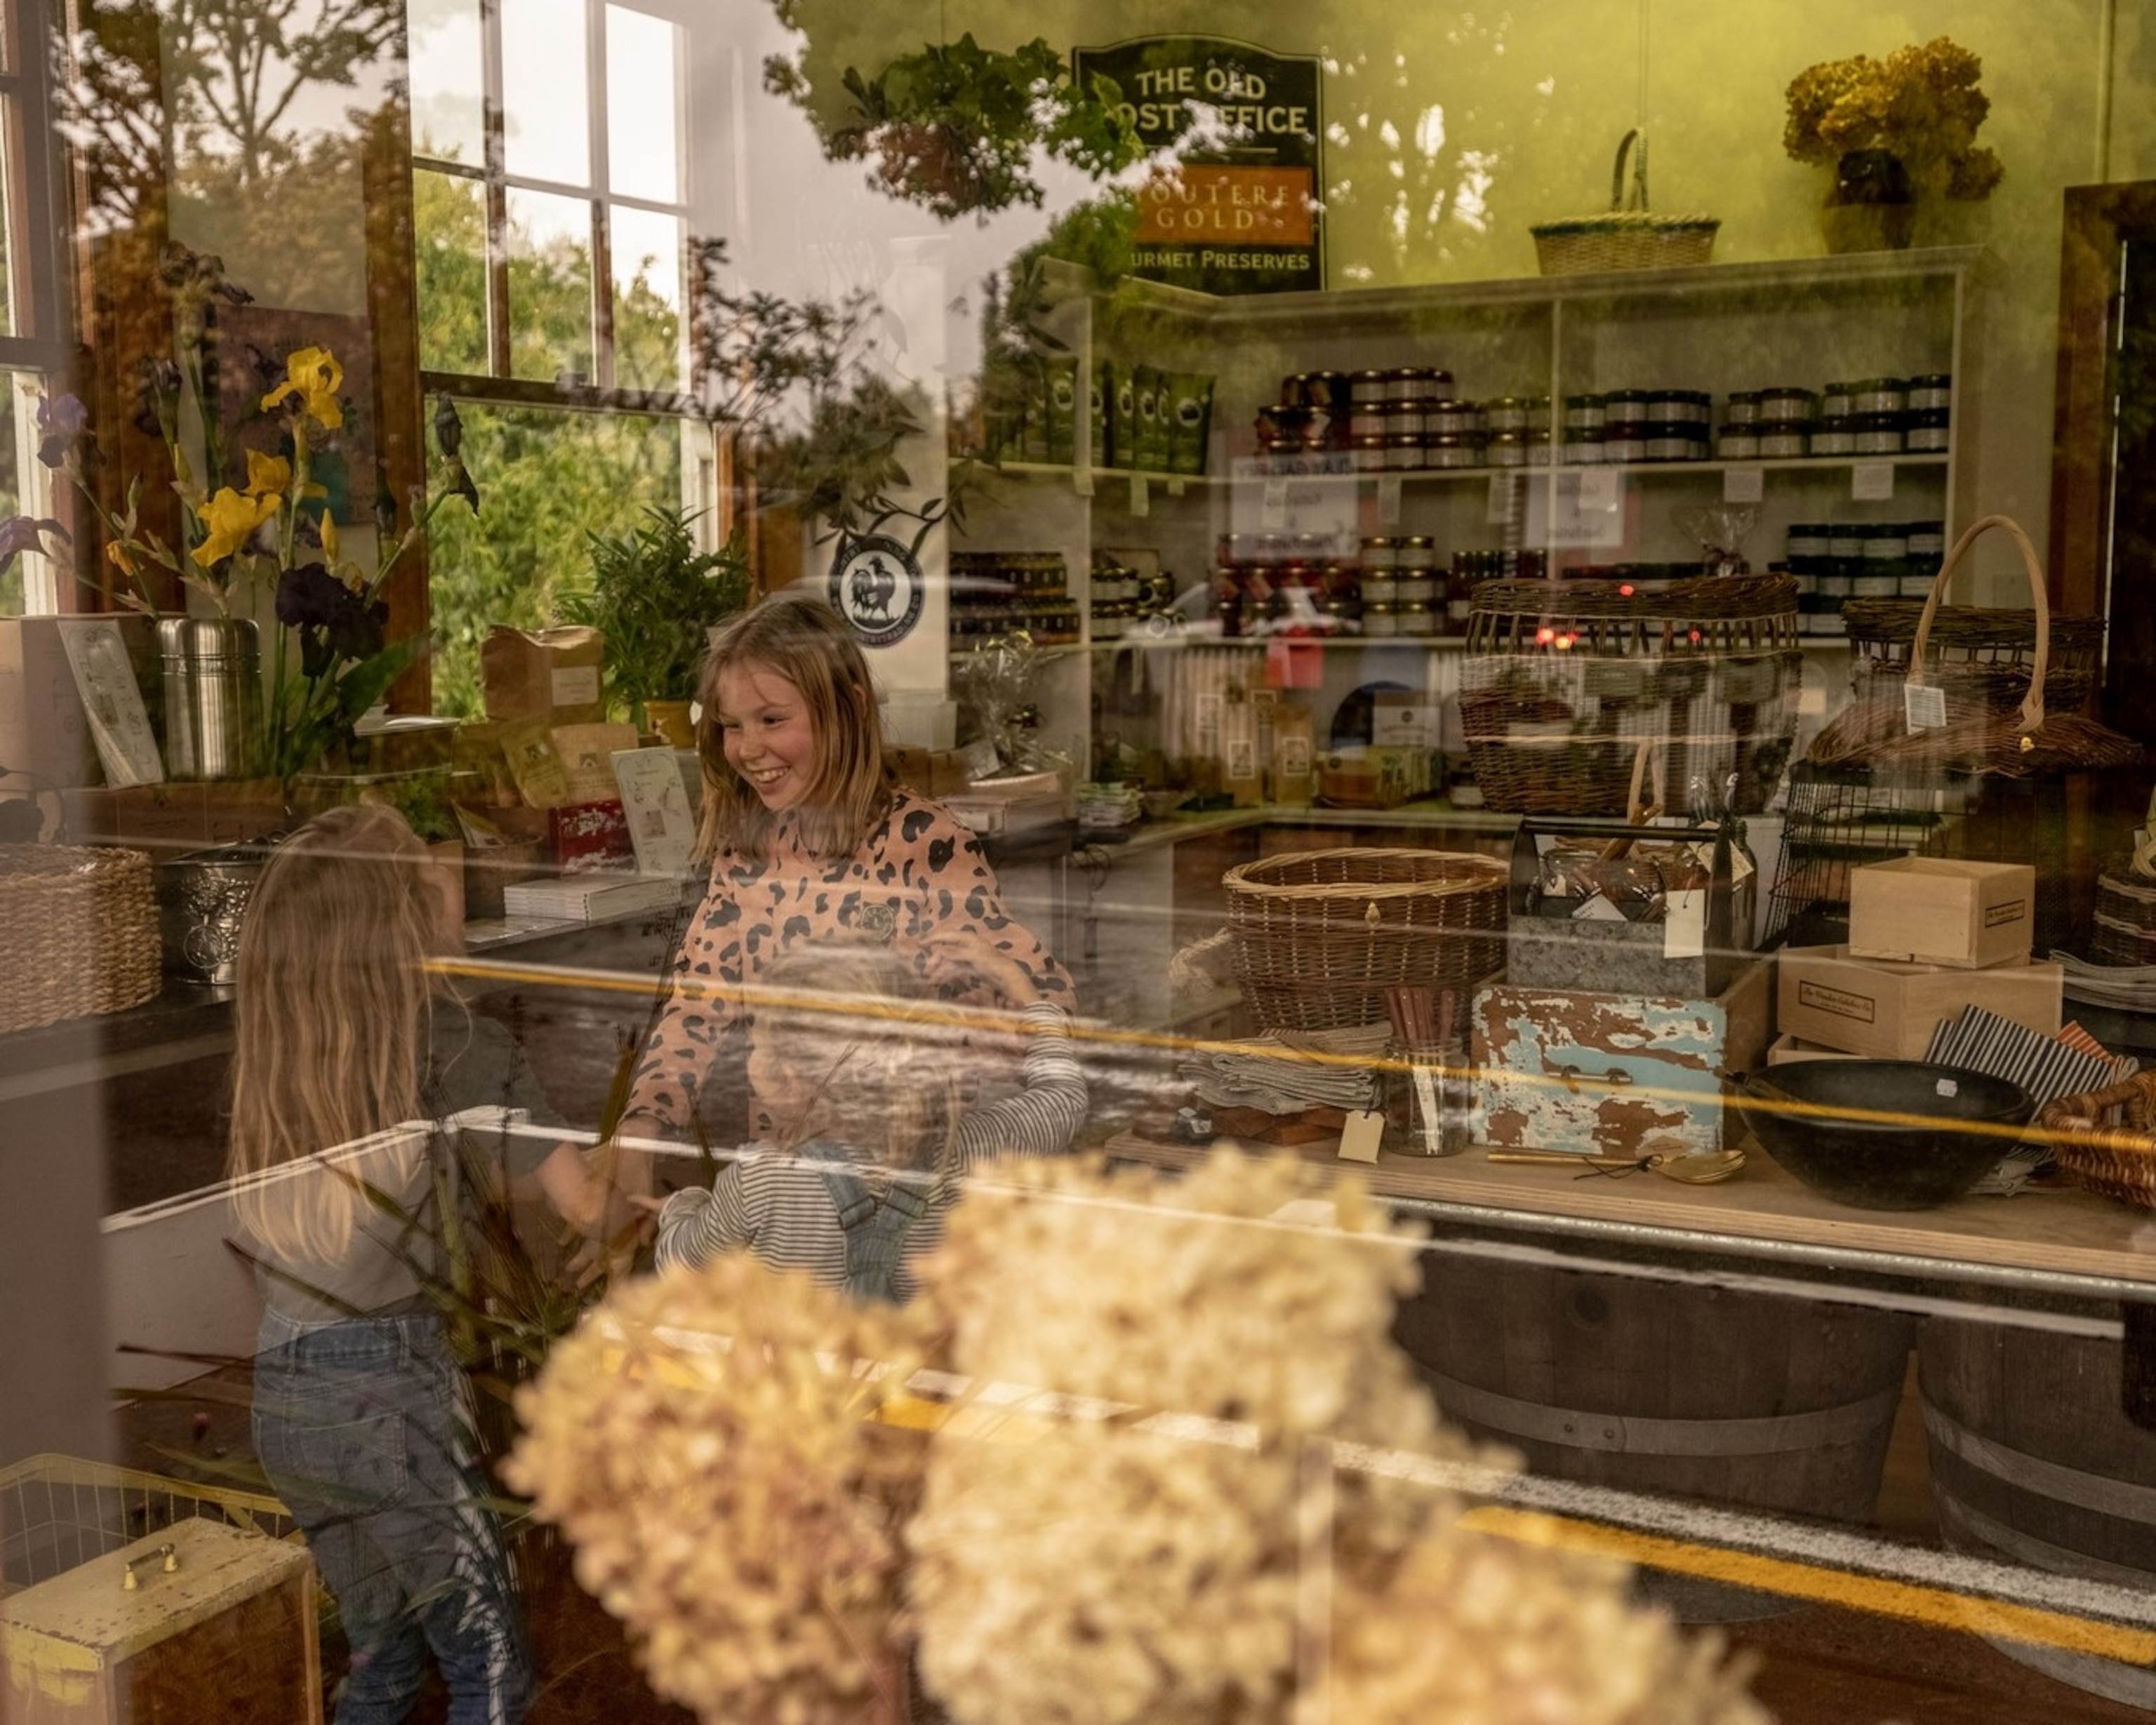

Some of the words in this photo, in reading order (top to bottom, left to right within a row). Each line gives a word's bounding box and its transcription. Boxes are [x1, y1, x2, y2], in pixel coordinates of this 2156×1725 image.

[1134, 67, 1195, 97] THE
[1204, 68, 1266, 99] OLD
[1118, 102, 1182, 131] OST
[1210, 105, 1309, 135] FFICE
[1134, 184, 1289, 206] OUTERE
[1156, 208, 1254, 229] GOLD
[1131, 251, 1194, 268] URMET
[1201, 249, 1310, 270] PRESERVES
